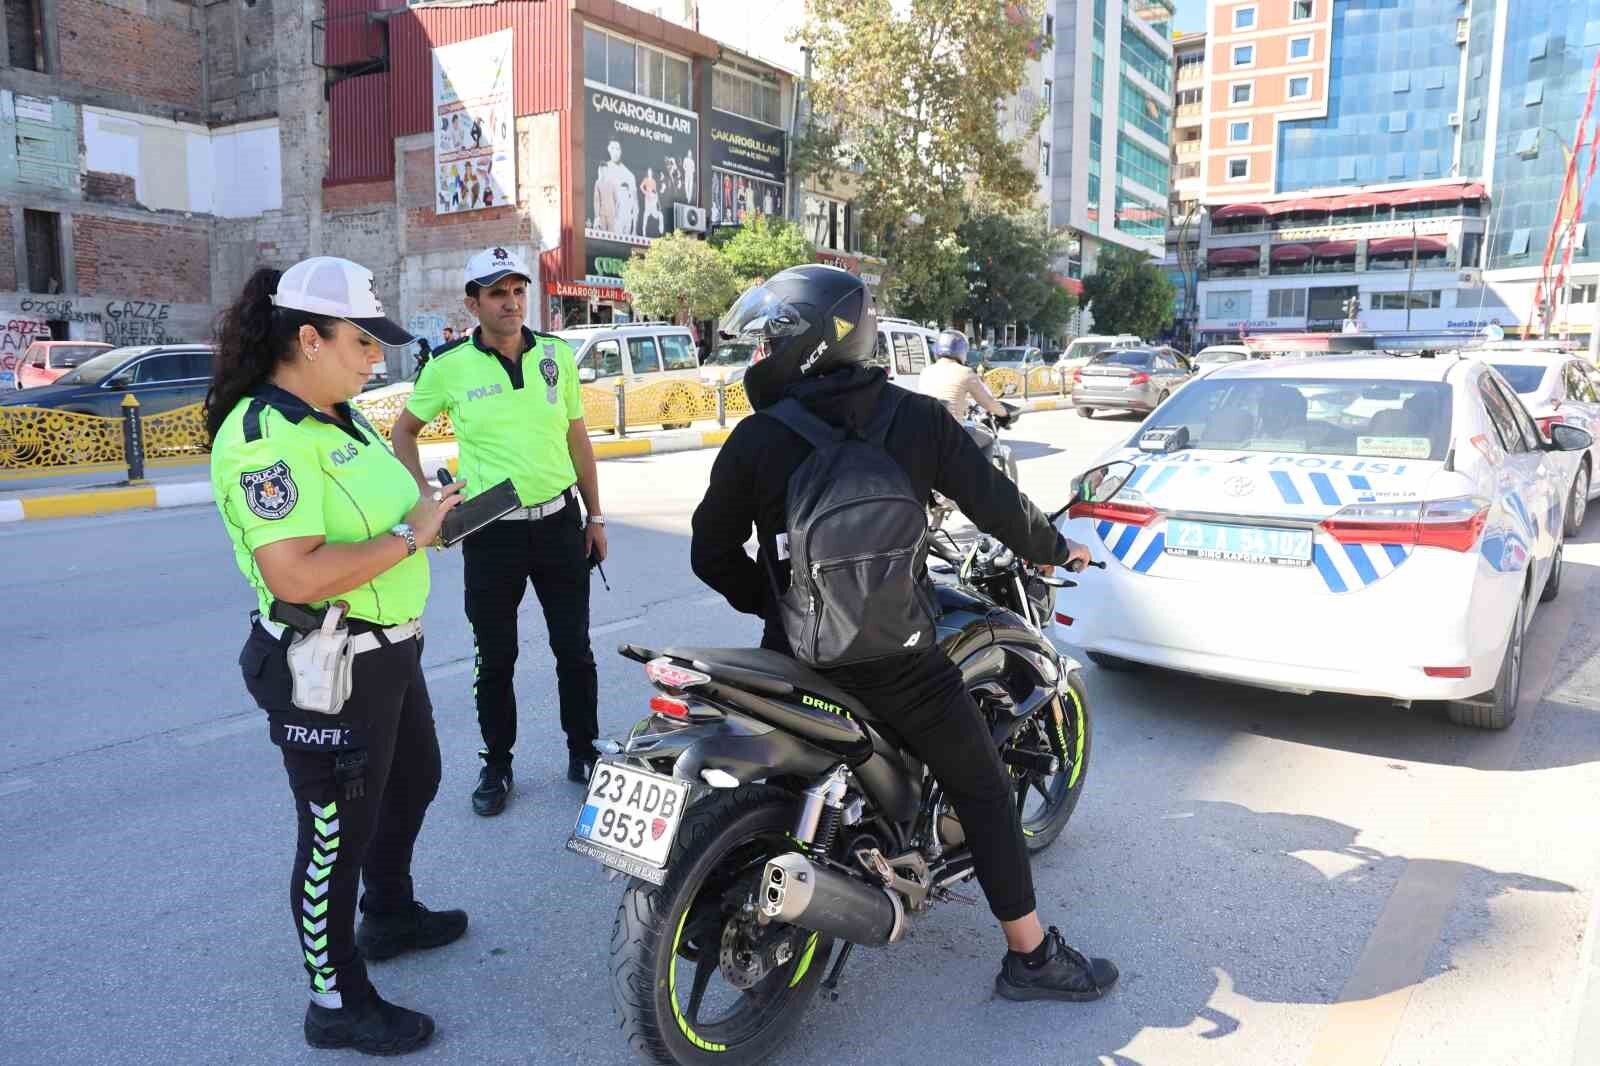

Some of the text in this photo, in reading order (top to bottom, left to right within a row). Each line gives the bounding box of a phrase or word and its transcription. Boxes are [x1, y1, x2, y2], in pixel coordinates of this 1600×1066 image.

[592, 93, 691, 135] ÇAKAROĞULLARI
[106, 301, 173, 320] GAZZE
[593, 770, 677, 818] 23 ADB
[598, 808, 647, 848] 953
